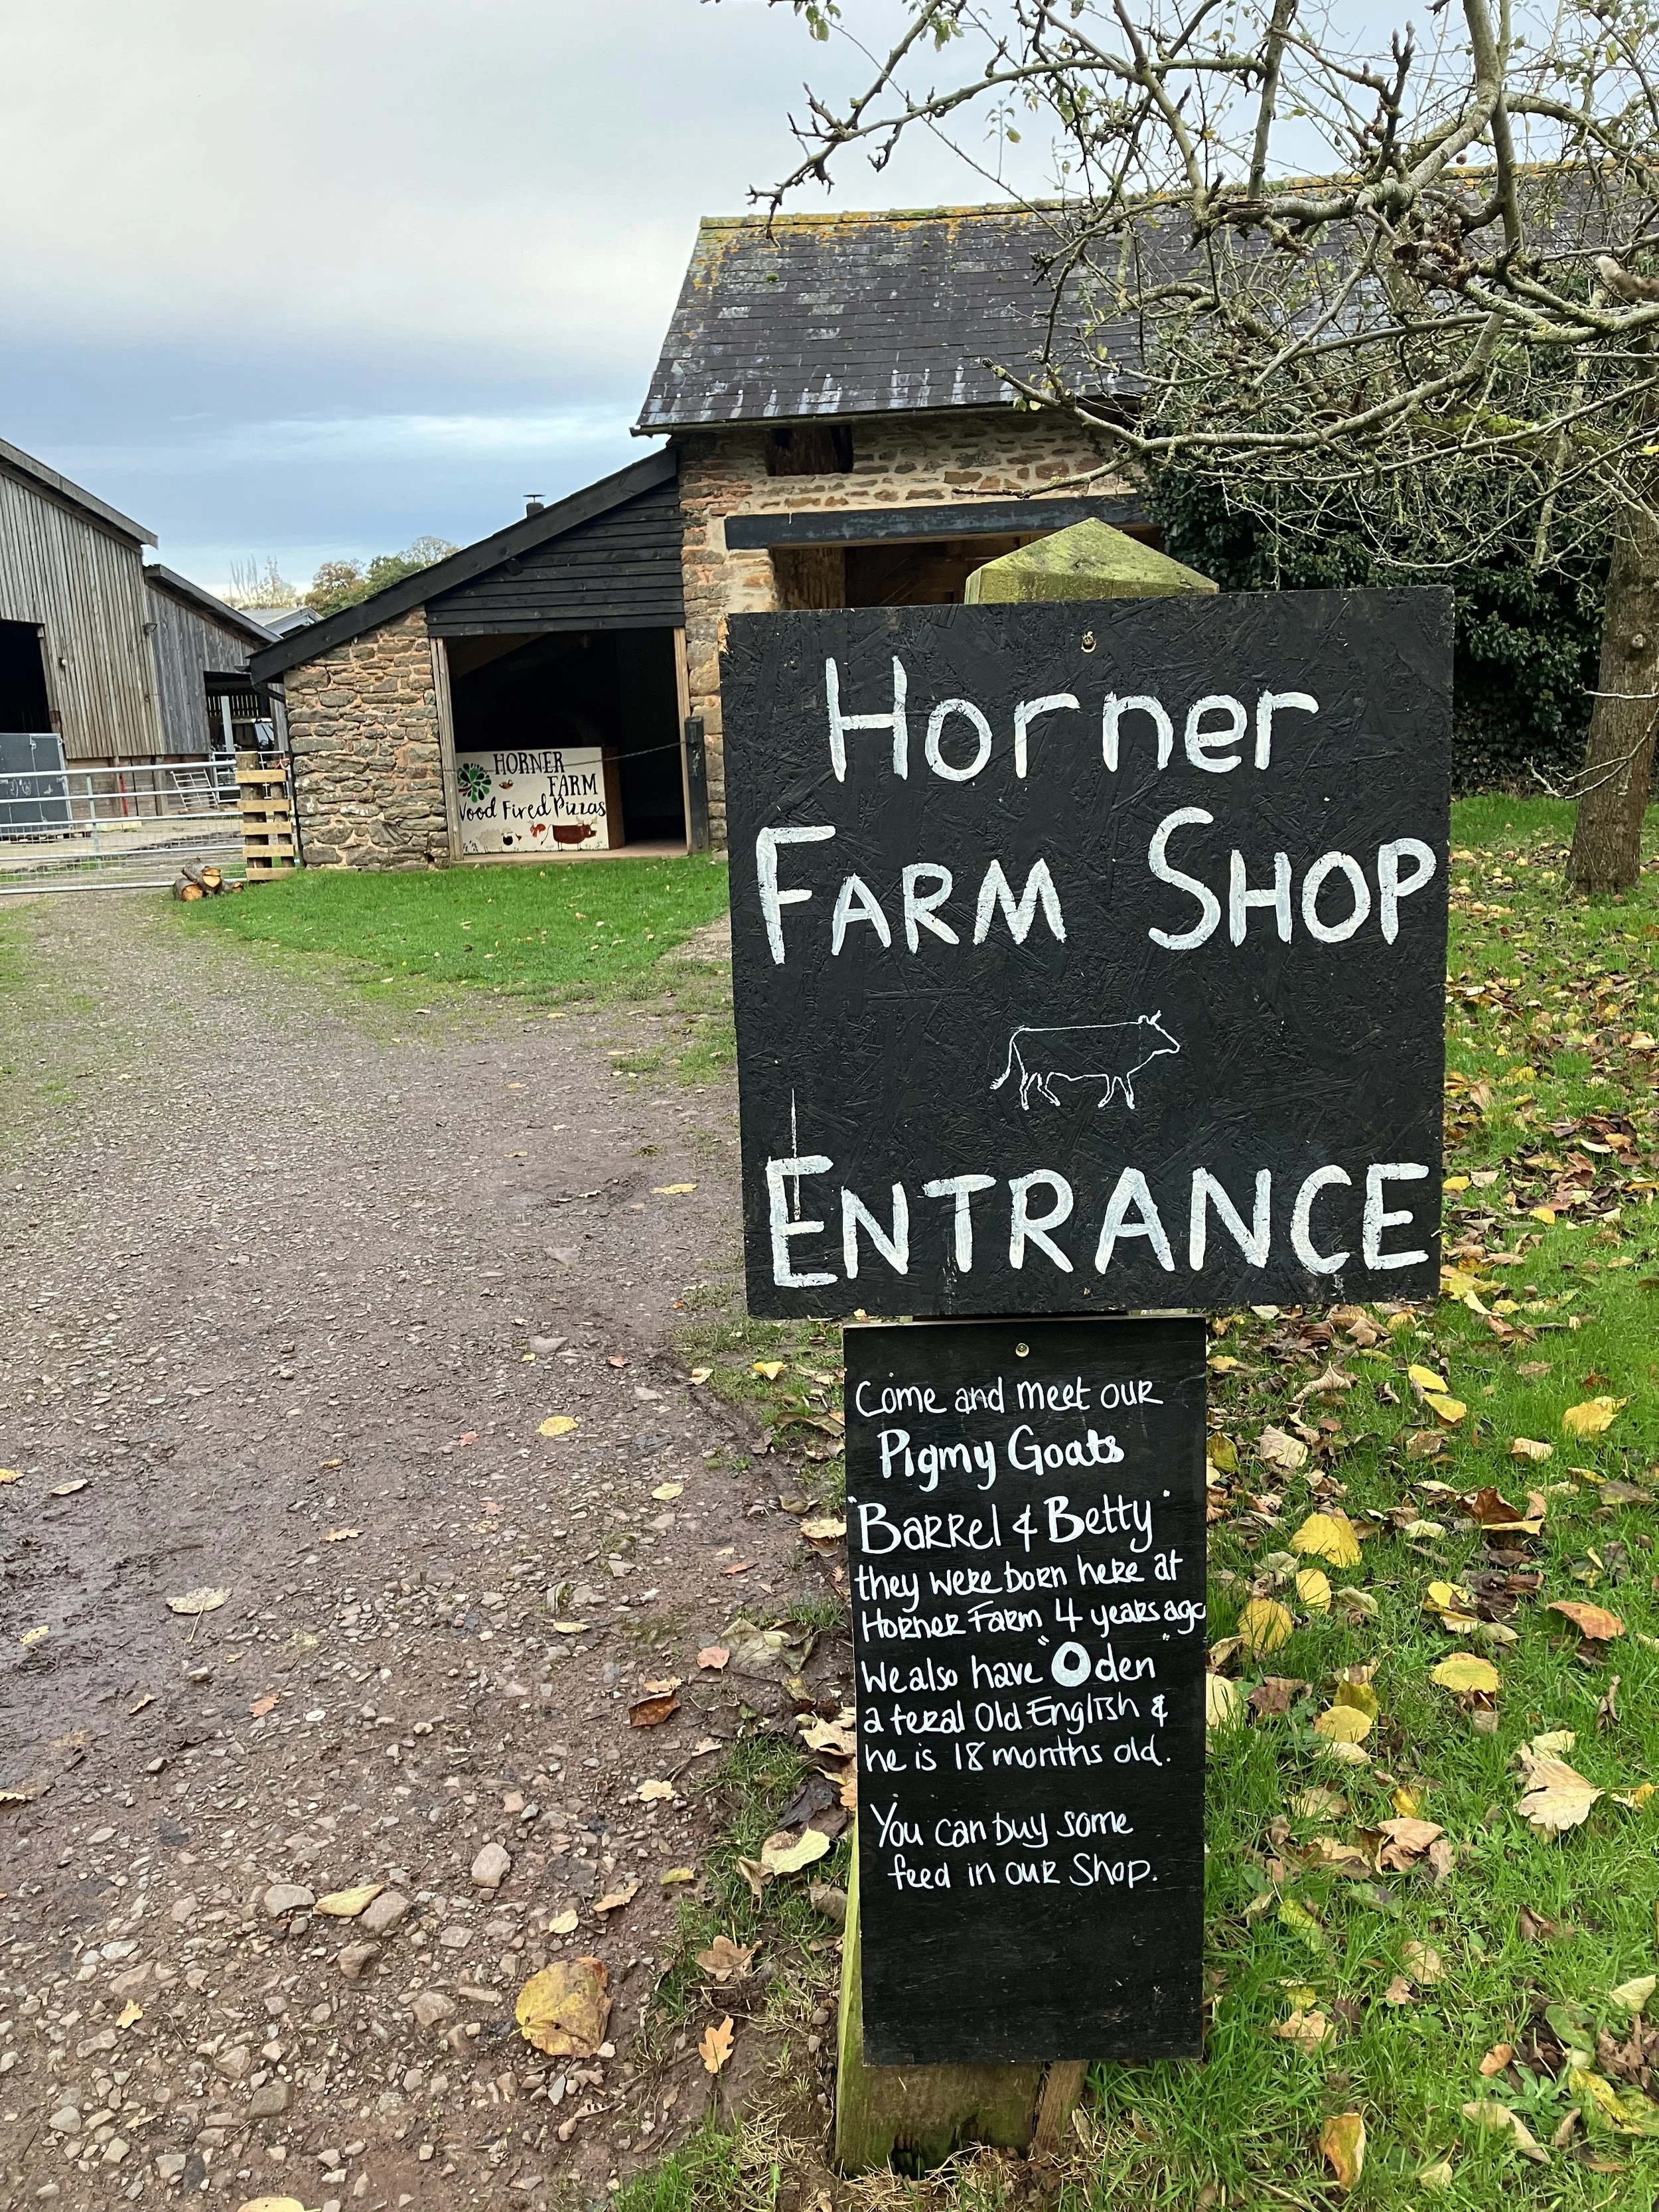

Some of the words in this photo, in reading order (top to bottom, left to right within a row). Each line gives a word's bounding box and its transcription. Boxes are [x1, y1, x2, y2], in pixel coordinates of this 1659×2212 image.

[825, 655, 1319, 783] Horner
[492, 751, 565, 775] HORNER
[547, 773, 598, 797] FARM
[502, 793, 551, 820] Fired
[553, 796, 607, 818] Pizzas
[755, 825, 1068, 965] FARM
[1147, 806, 1437, 950] SHOP
[764, 1157, 1429, 1289] ENTRANCE
[855, 1380, 948, 1418] Come
[954, 1376, 1005, 1414] and
[1017, 1376, 1091, 1411] meet
[877, 1429, 997, 1493] Pigmy
[1007, 1424, 1125, 1476] Goats
[853, 1564, 920, 1613] they
[929, 1568, 1003, 1596] were
[1003, 1560, 1068, 1593] born
[1076, 1554, 1145, 1586] here
[1153, 1549, 1184, 1581] at
[861, 1607, 967, 1643] Horner
[967, 1600, 1043, 1633] Farm
[1055, 1597, 1084, 1633] 4
[1090, 1599, 1161, 1639] years
[1163, 1599, 1207, 1635] ago
[971, 1655, 1044, 1689] have
[863, 1707, 885, 1733] a
[975, 1700, 1023, 1732] Old
[1026, 1691, 1140, 1735] English
[865, 1743, 907, 1773] he
[915, 1742, 938, 1771] is
[955, 1741, 986, 1771] 18
[992, 1735, 1103, 1769] months
[1114, 1733, 1172, 1766] old.
[869, 1802, 924, 1848] You
[935, 1818, 987, 1848] can
[991, 1812, 1049, 1848] buy
[1056, 1810, 1134, 1838] some
[887, 1854, 952, 1890] feed
[968, 1862, 996, 1887] in
[1005, 1860, 1061, 1885] our
[1068, 1852, 1159, 1889] Shop.
